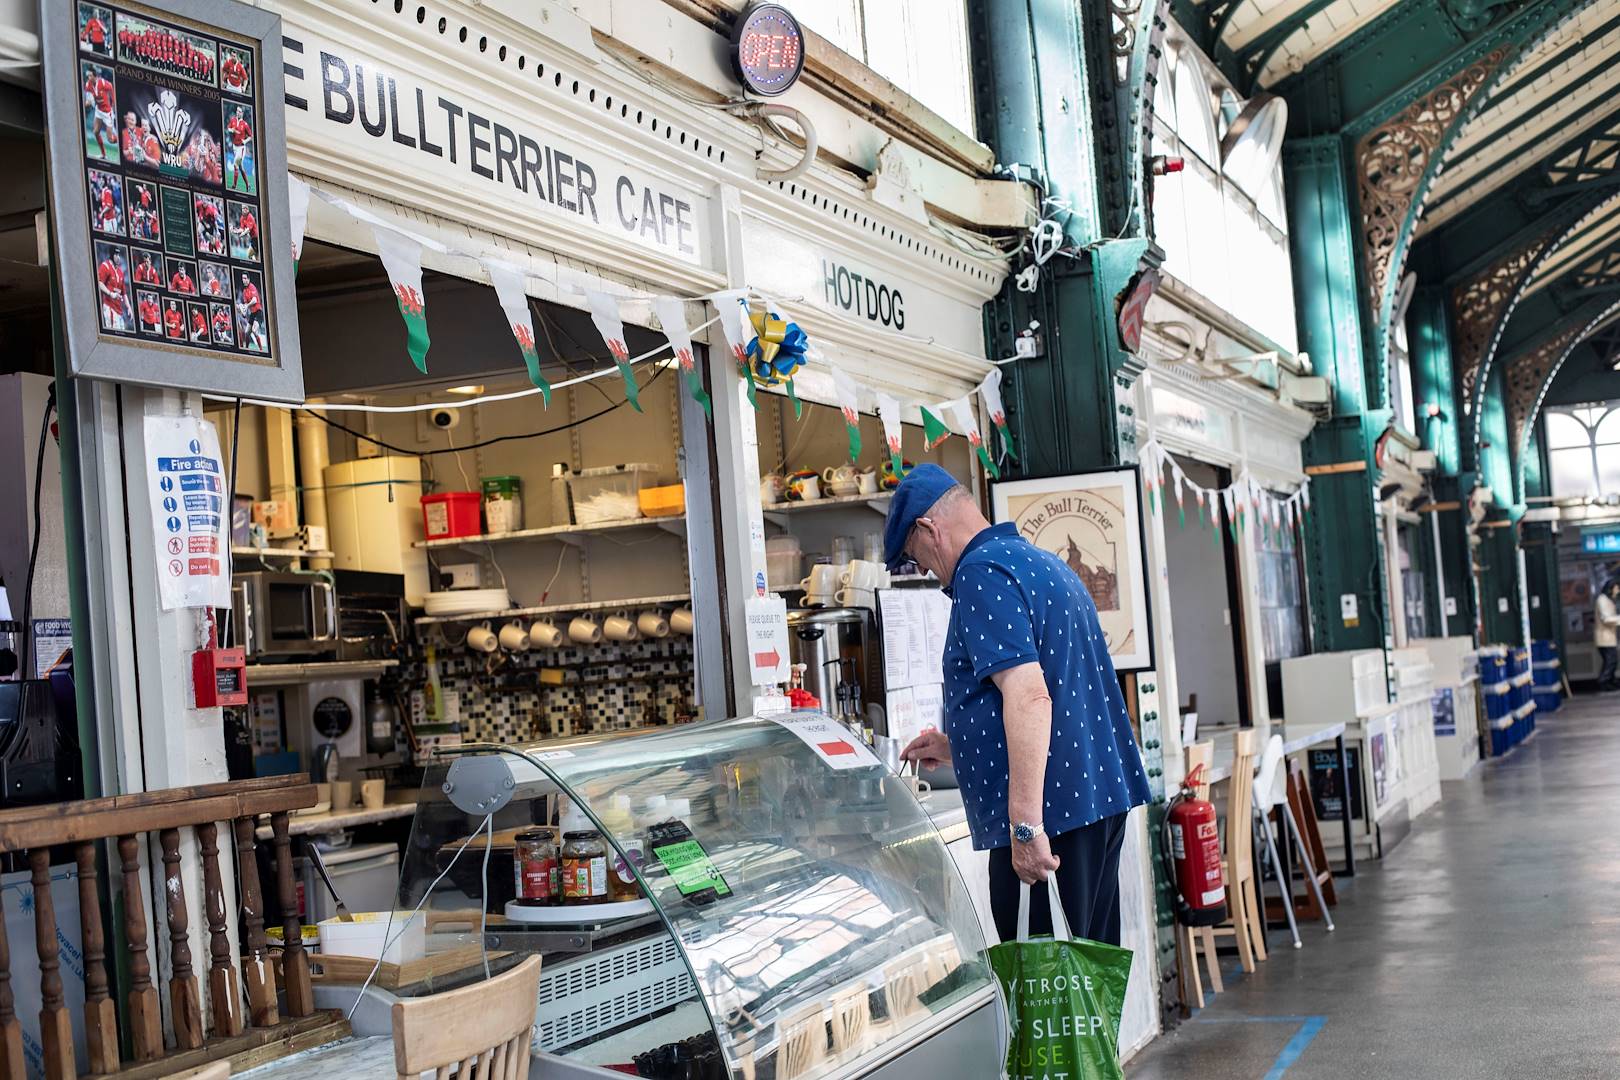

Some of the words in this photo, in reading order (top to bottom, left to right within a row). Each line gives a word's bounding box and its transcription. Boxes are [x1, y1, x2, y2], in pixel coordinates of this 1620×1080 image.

[743, 32, 799, 68] OPEN
[115, 65, 144, 79] GRAND
[145, 72, 167, 86] SLAM
[167, 79, 202, 95] WINNERS
[203, 88, 220, 100] 2005
[162, 152, 182, 167] WRU
[320, 51, 600, 225] BULLTERRIER
[616, 175, 694, 254] CAFE
[171, 459, 191, 470] Fire
[1020, 511, 1046, 536] The
[1044, 498, 1071, 517] Bull
[1074, 497, 1113, 530] Terrier
[45, 621, 60, 629] FOOD
[1008, 975, 1093, 994] TROSE
[1023, 996, 1069, 1007] ARTNERS
[1033, 1015, 1107, 1039] SLEEP.
